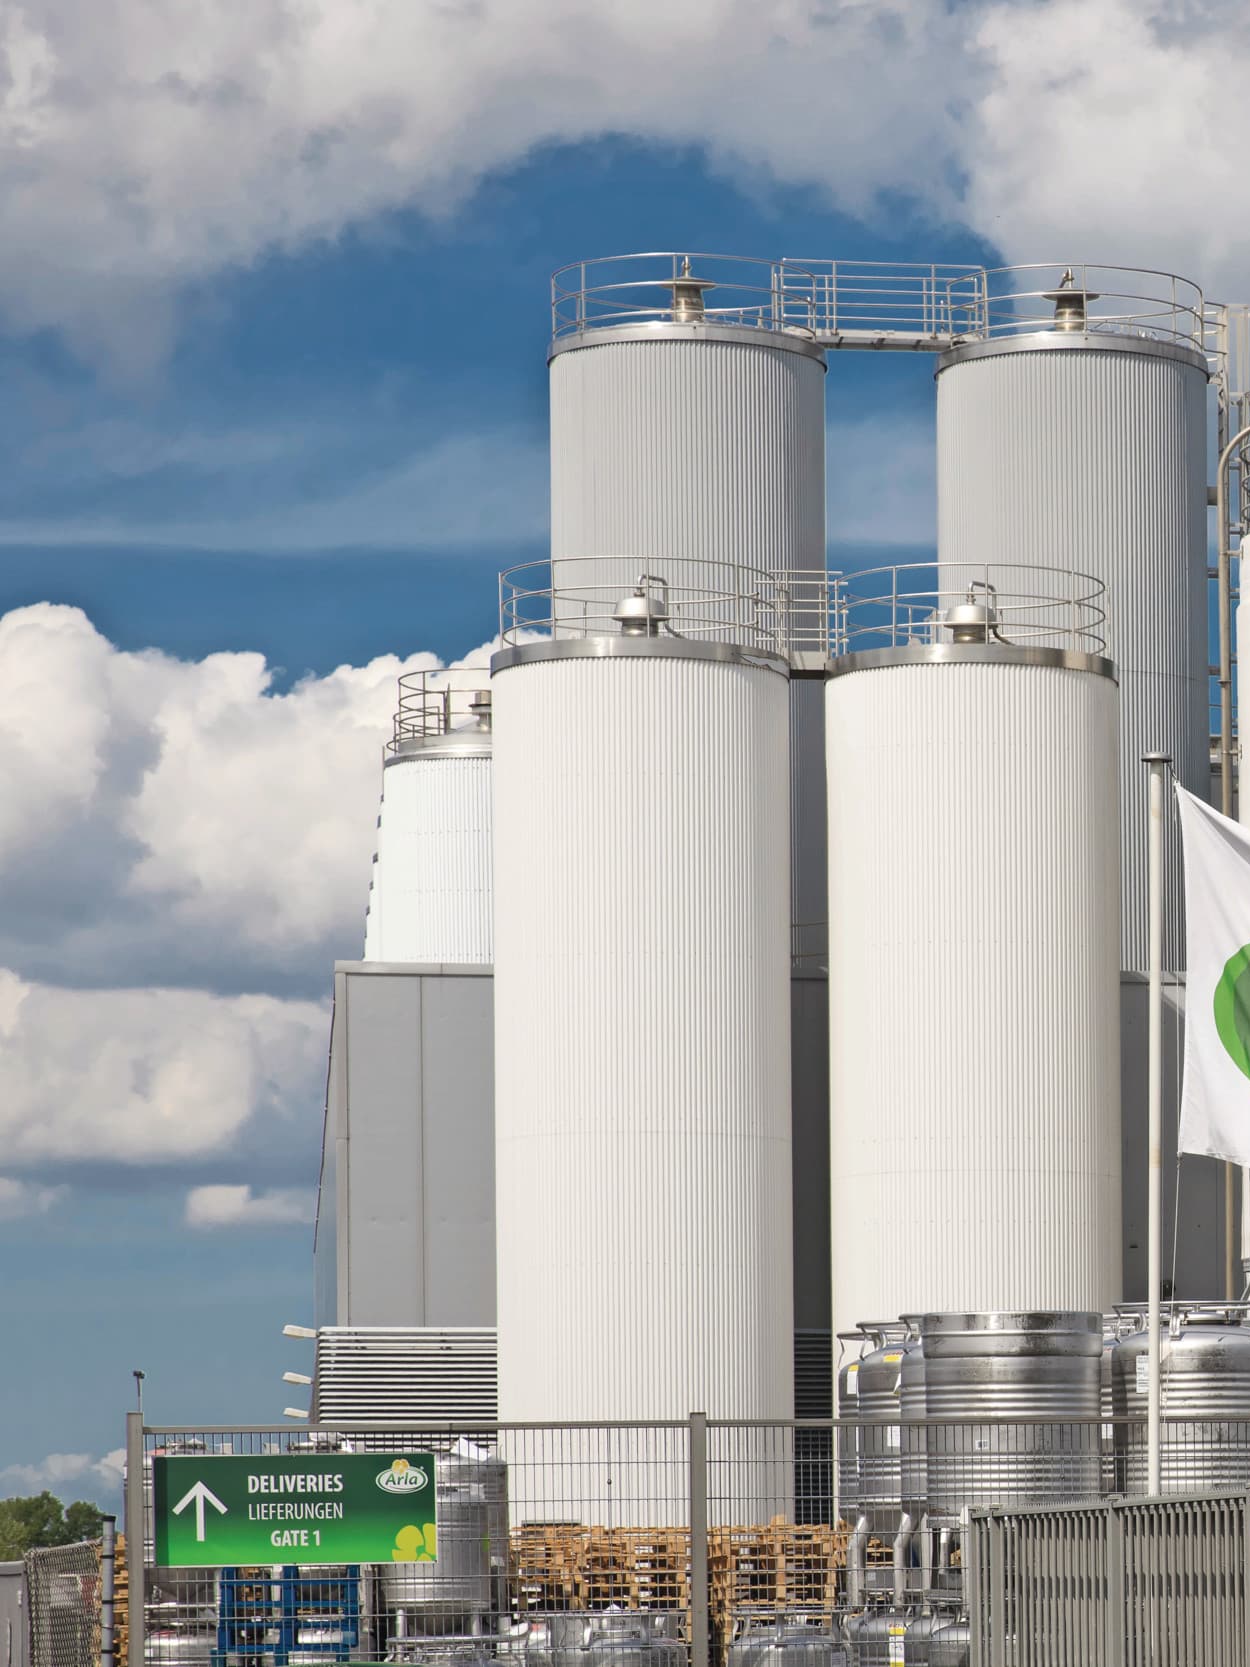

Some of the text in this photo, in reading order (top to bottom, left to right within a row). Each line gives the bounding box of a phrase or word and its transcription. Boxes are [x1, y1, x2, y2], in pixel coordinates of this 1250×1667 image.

[247, 1474, 344, 1494] DELIVERIES
[385, 1472, 418, 1486] Arla
[248, 1502, 343, 1520] LIEFERUNGEN
[270, 1530, 321, 1547] GATE 1
